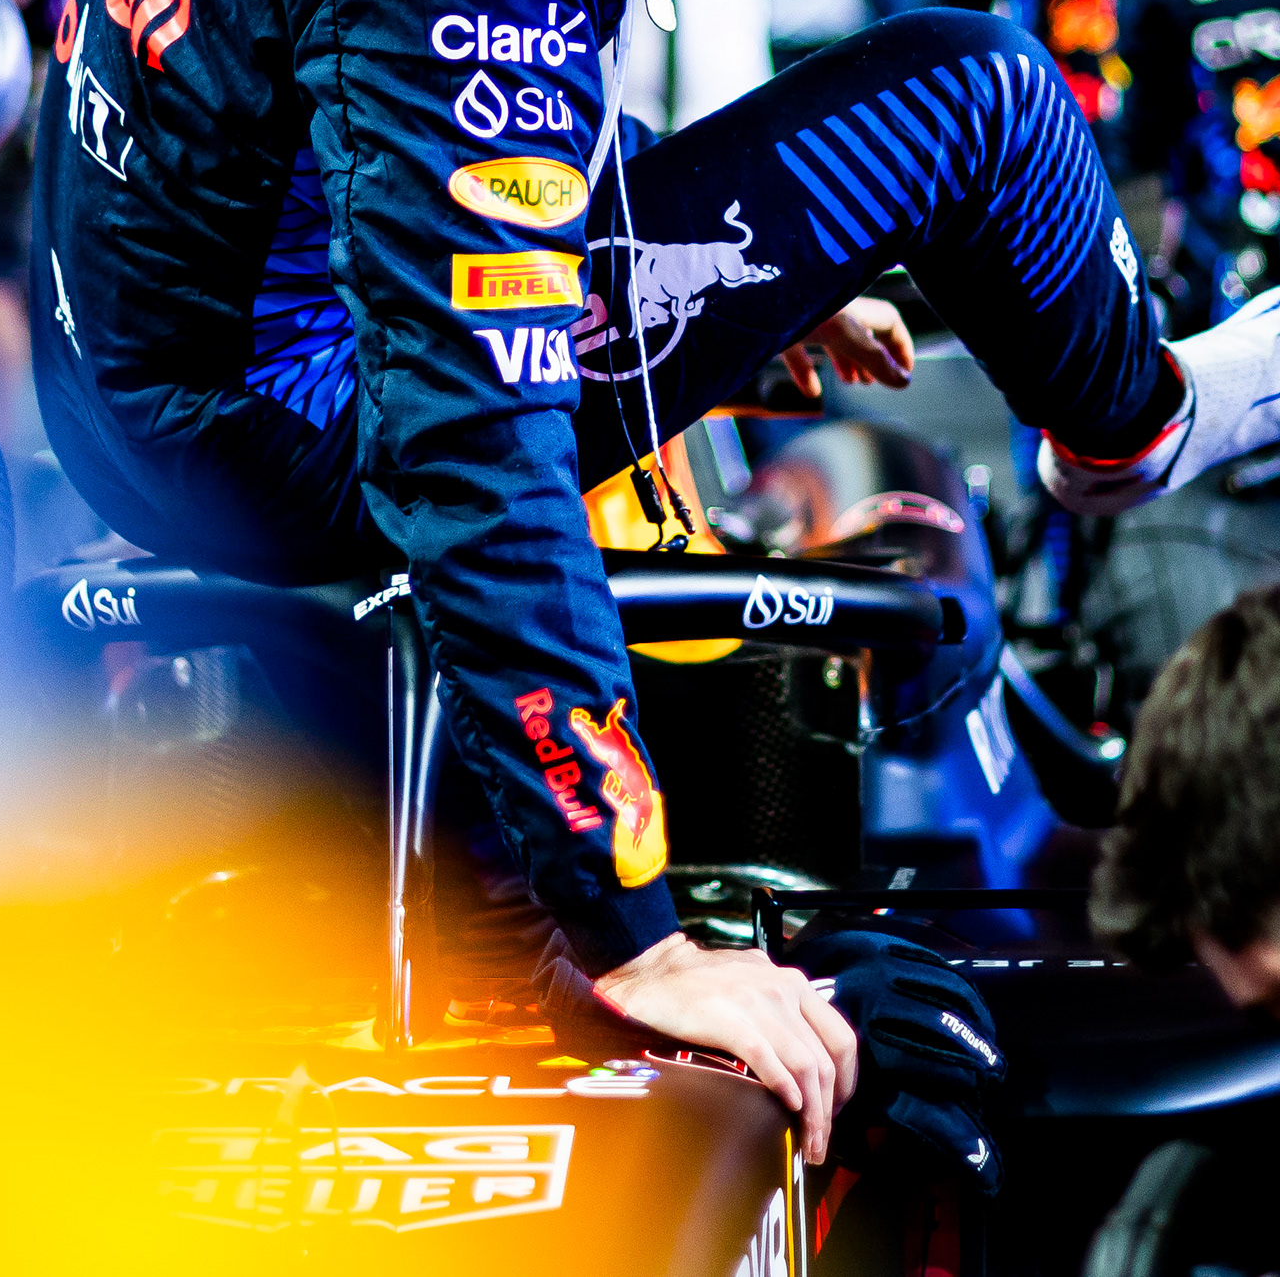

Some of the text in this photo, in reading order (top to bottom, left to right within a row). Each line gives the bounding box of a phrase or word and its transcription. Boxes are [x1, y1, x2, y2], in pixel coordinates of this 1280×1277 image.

[431, 13, 570, 68] Claro
[515, 87, 573, 131] Sui
[489, 178, 573, 207] RAUCH
[472, 326, 578, 384] VISA
[94, 587, 142, 626] Sui
[783, 586, 835, 625] Sui
[158, 1074, 651, 1099] ORACLE
[186, 1135, 531, 1162] TAG
[156, 1176, 537, 1215] HEUER
